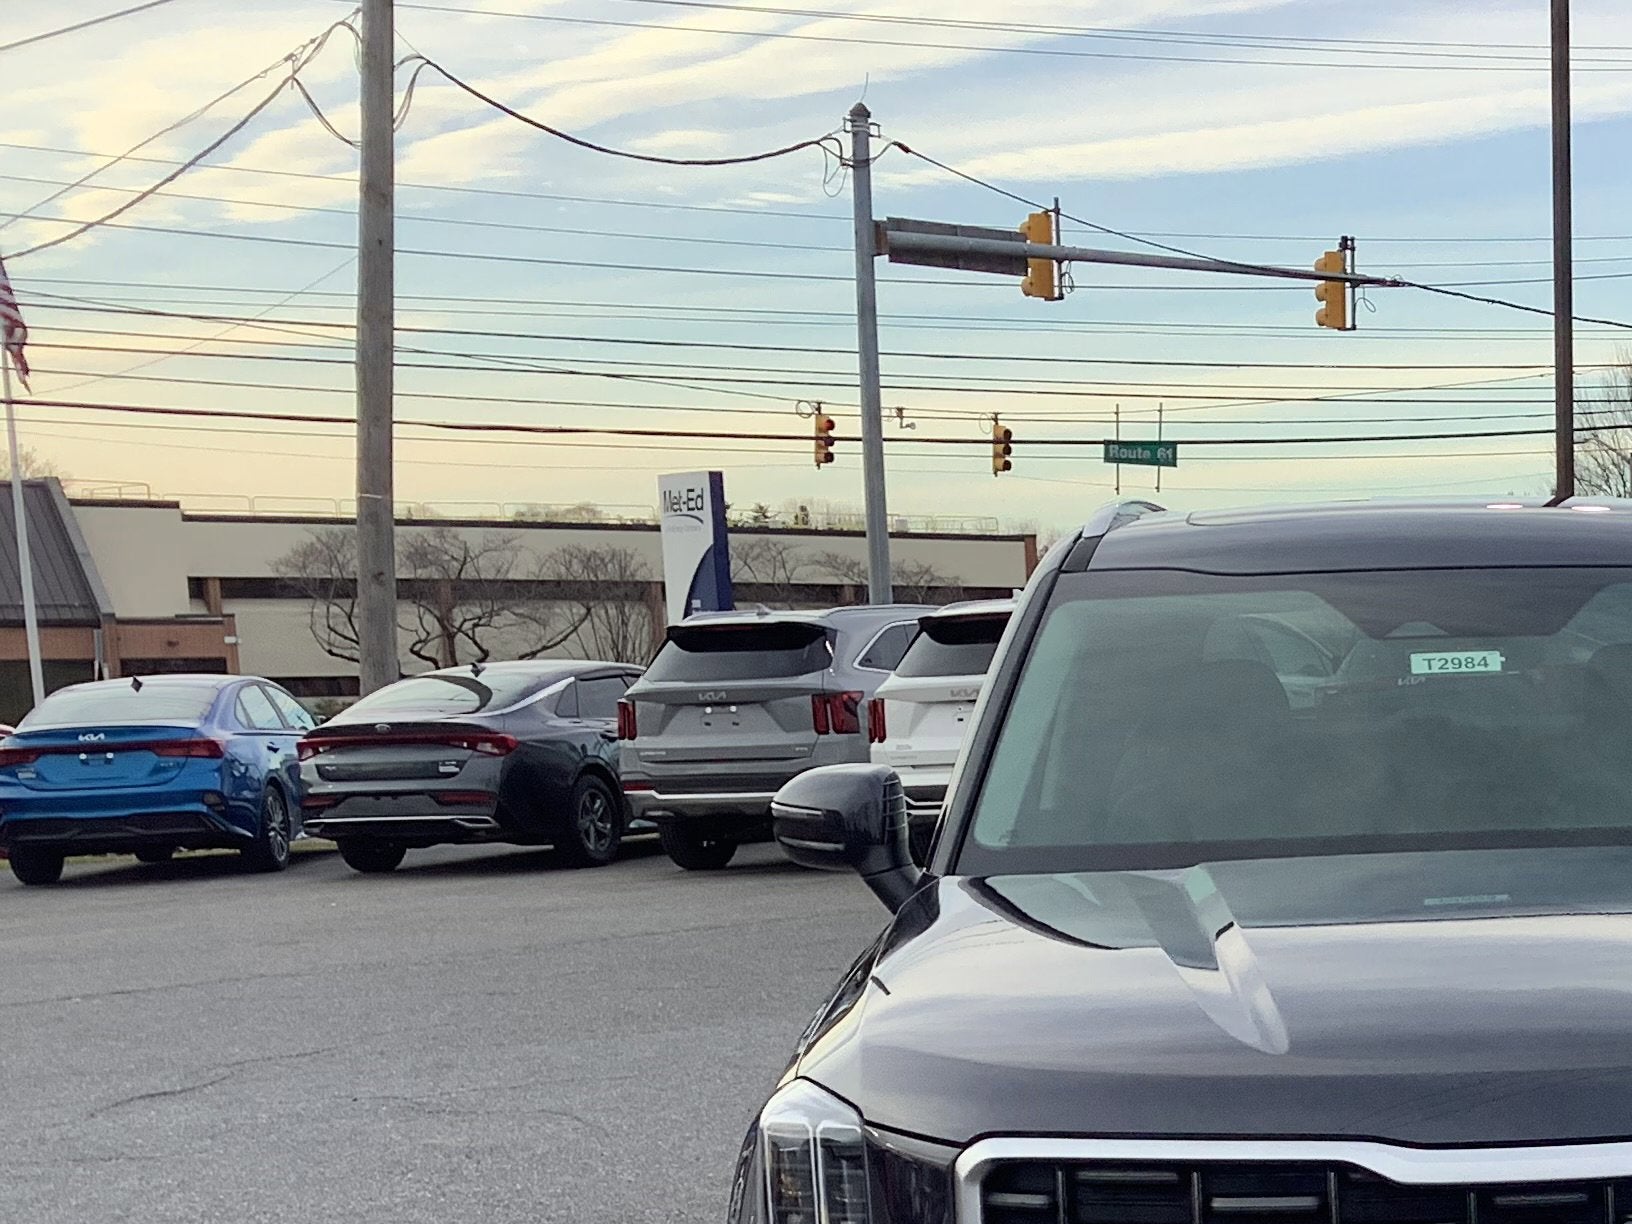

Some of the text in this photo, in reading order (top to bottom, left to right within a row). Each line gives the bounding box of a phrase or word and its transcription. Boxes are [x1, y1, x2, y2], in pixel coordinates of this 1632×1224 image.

[1109, 444, 1173, 459] Route 61
[663, 488, 704, 512] Met-Ed
[1422, 656, 1490, 671] T2984
